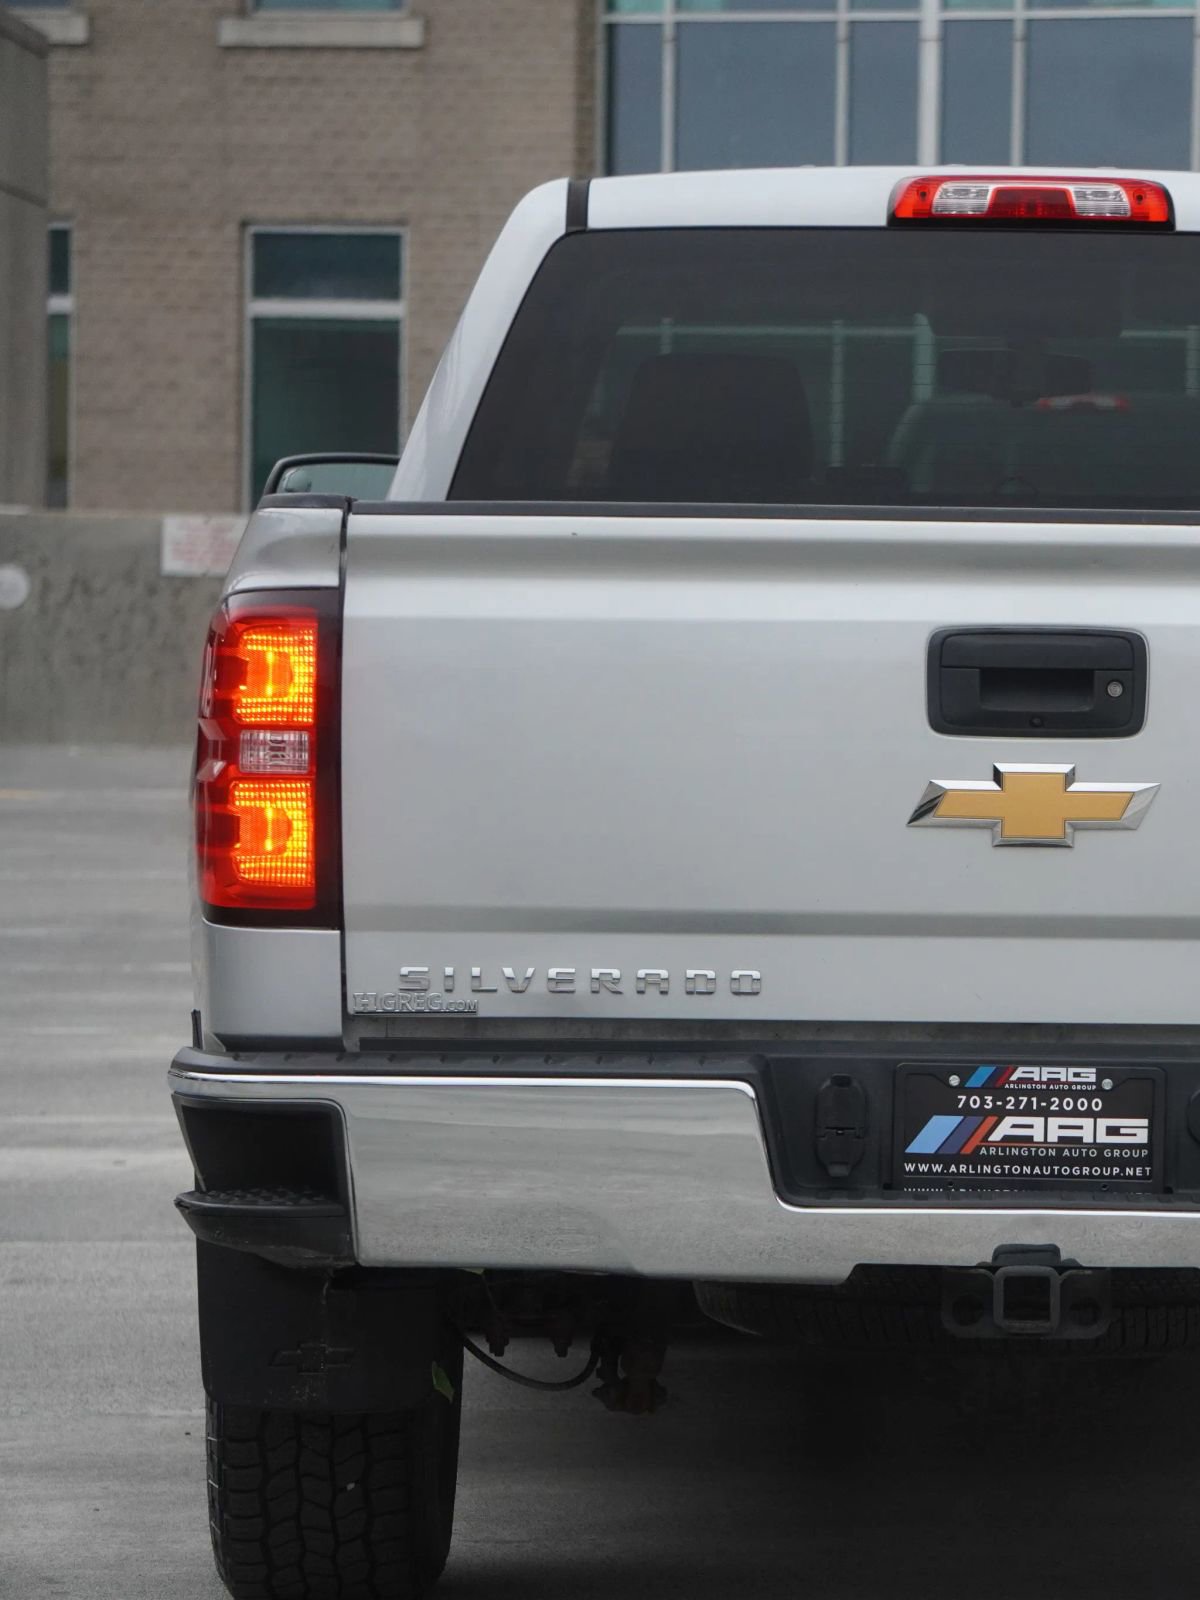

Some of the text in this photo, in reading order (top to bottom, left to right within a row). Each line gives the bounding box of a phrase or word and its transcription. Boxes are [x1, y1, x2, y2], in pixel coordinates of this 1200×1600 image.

[399, 966, 762, 996] SILVERADO
[1009, 1066, 1097, 1082] AAG
[957, 1095, 1103, 1112] 703-271-2000
[987, 1116, 1149, 1144] AAG
[980, 1146, 1149, 1158] ARLINGTON AUTO GROUP
[904, 1162, 1152, 1177] WWW.ARLINGTONAUTOGROUP.NET
